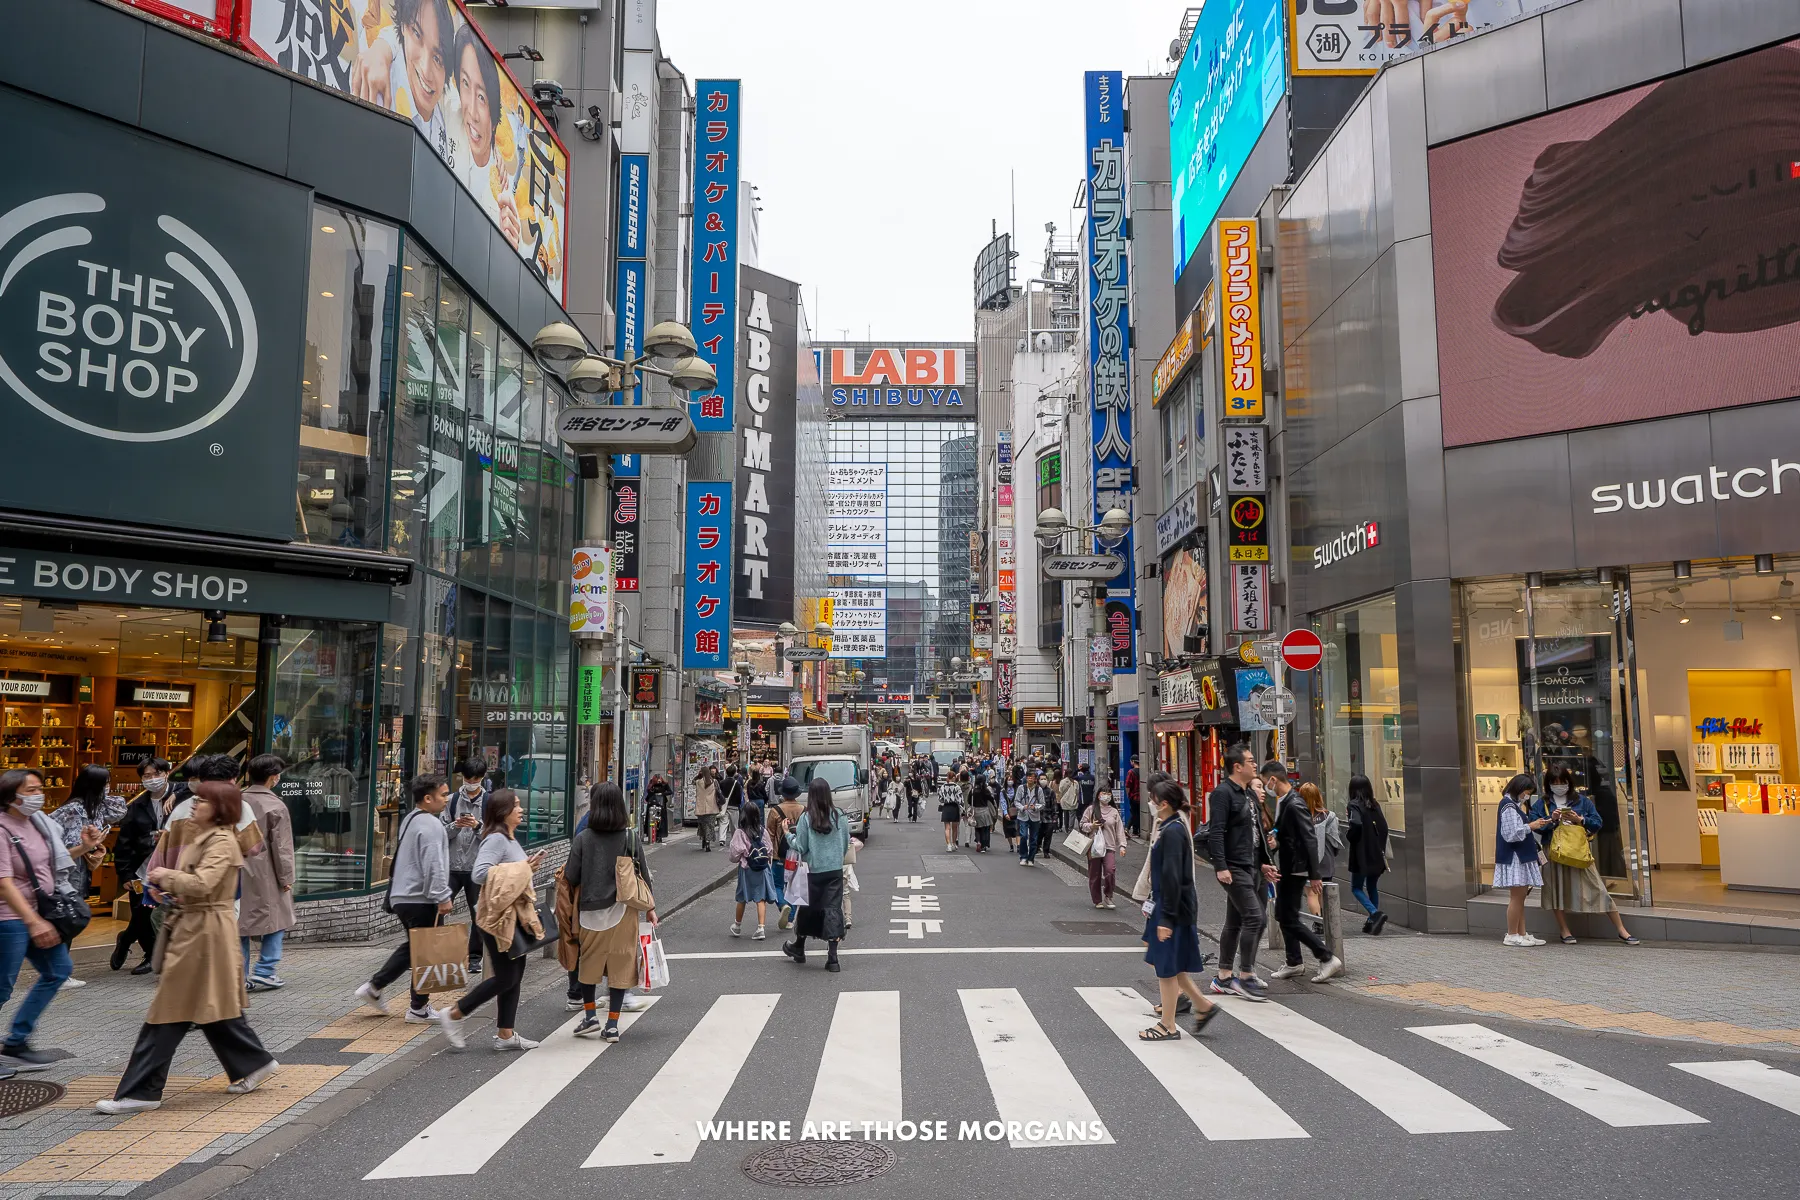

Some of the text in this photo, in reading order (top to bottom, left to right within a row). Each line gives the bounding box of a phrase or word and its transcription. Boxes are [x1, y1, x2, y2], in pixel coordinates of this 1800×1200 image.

[1099, 74, 1110, 123] キラクビル
[627, 163, 640, 250] SKECHERS
[78, 259, 174, 315] THE
[1091, 138, 1131, 462] カラオケの鉄人
[1225, 226, 1254, 391] プリクラのメッカ
[37, 290, 206, 363] BODY
[35, 341, 199, 403] SHOP
[831, 348, 965, 386] LABI
[407, 382, 452, 400] SINCE 1976
[832, 388, 963, 406] SHIBUYA
[1231, 397, 1257, 409] 3F
[563, 416, 684, 432] 渋谷センター街
[433, 414, 518, 468] BORN IN BRIGHTON
[1227, 432, 1249, 485] ふたご
[1096, 467, 1131, 488] 2F
[1592, 458, 1800, 514] swatch
[614, 486, 637, 524] HUB
[1235, 502, 1260, 522] 油
[624, 531, 634, 554] ALE
[1238, 530, 1258, 542] そば
[1314, 523, 1366, 570] swatch
[616, 531, 625, 572] HOUSE
[1049, 560, 1118, 571] 渋谷センター街
[1233, 547, 1265, 559] 春日亭
[33, 560, 143, 595] BODY
[573, 559, 590, 575] Enjoy
[695, 493, 720, 655] カラオケ館
[1108, 611, 1129, 651] HUB
[1114, 656, 1129, 667] 1F
[1, 682, 39, 693] YOUR BODY
[142, 691, 155, 699] LOVE
[583, 669, 594, 721] 客引きは犯罪です
[1544, 677, 1585, 685] OMEGA
[1539, 696, 1585, 705] swatch
[121, 752, 136, 761] TRY
[281, 789, 303, 797] CLOSE
[415, 961, 469, 991] ZARA
